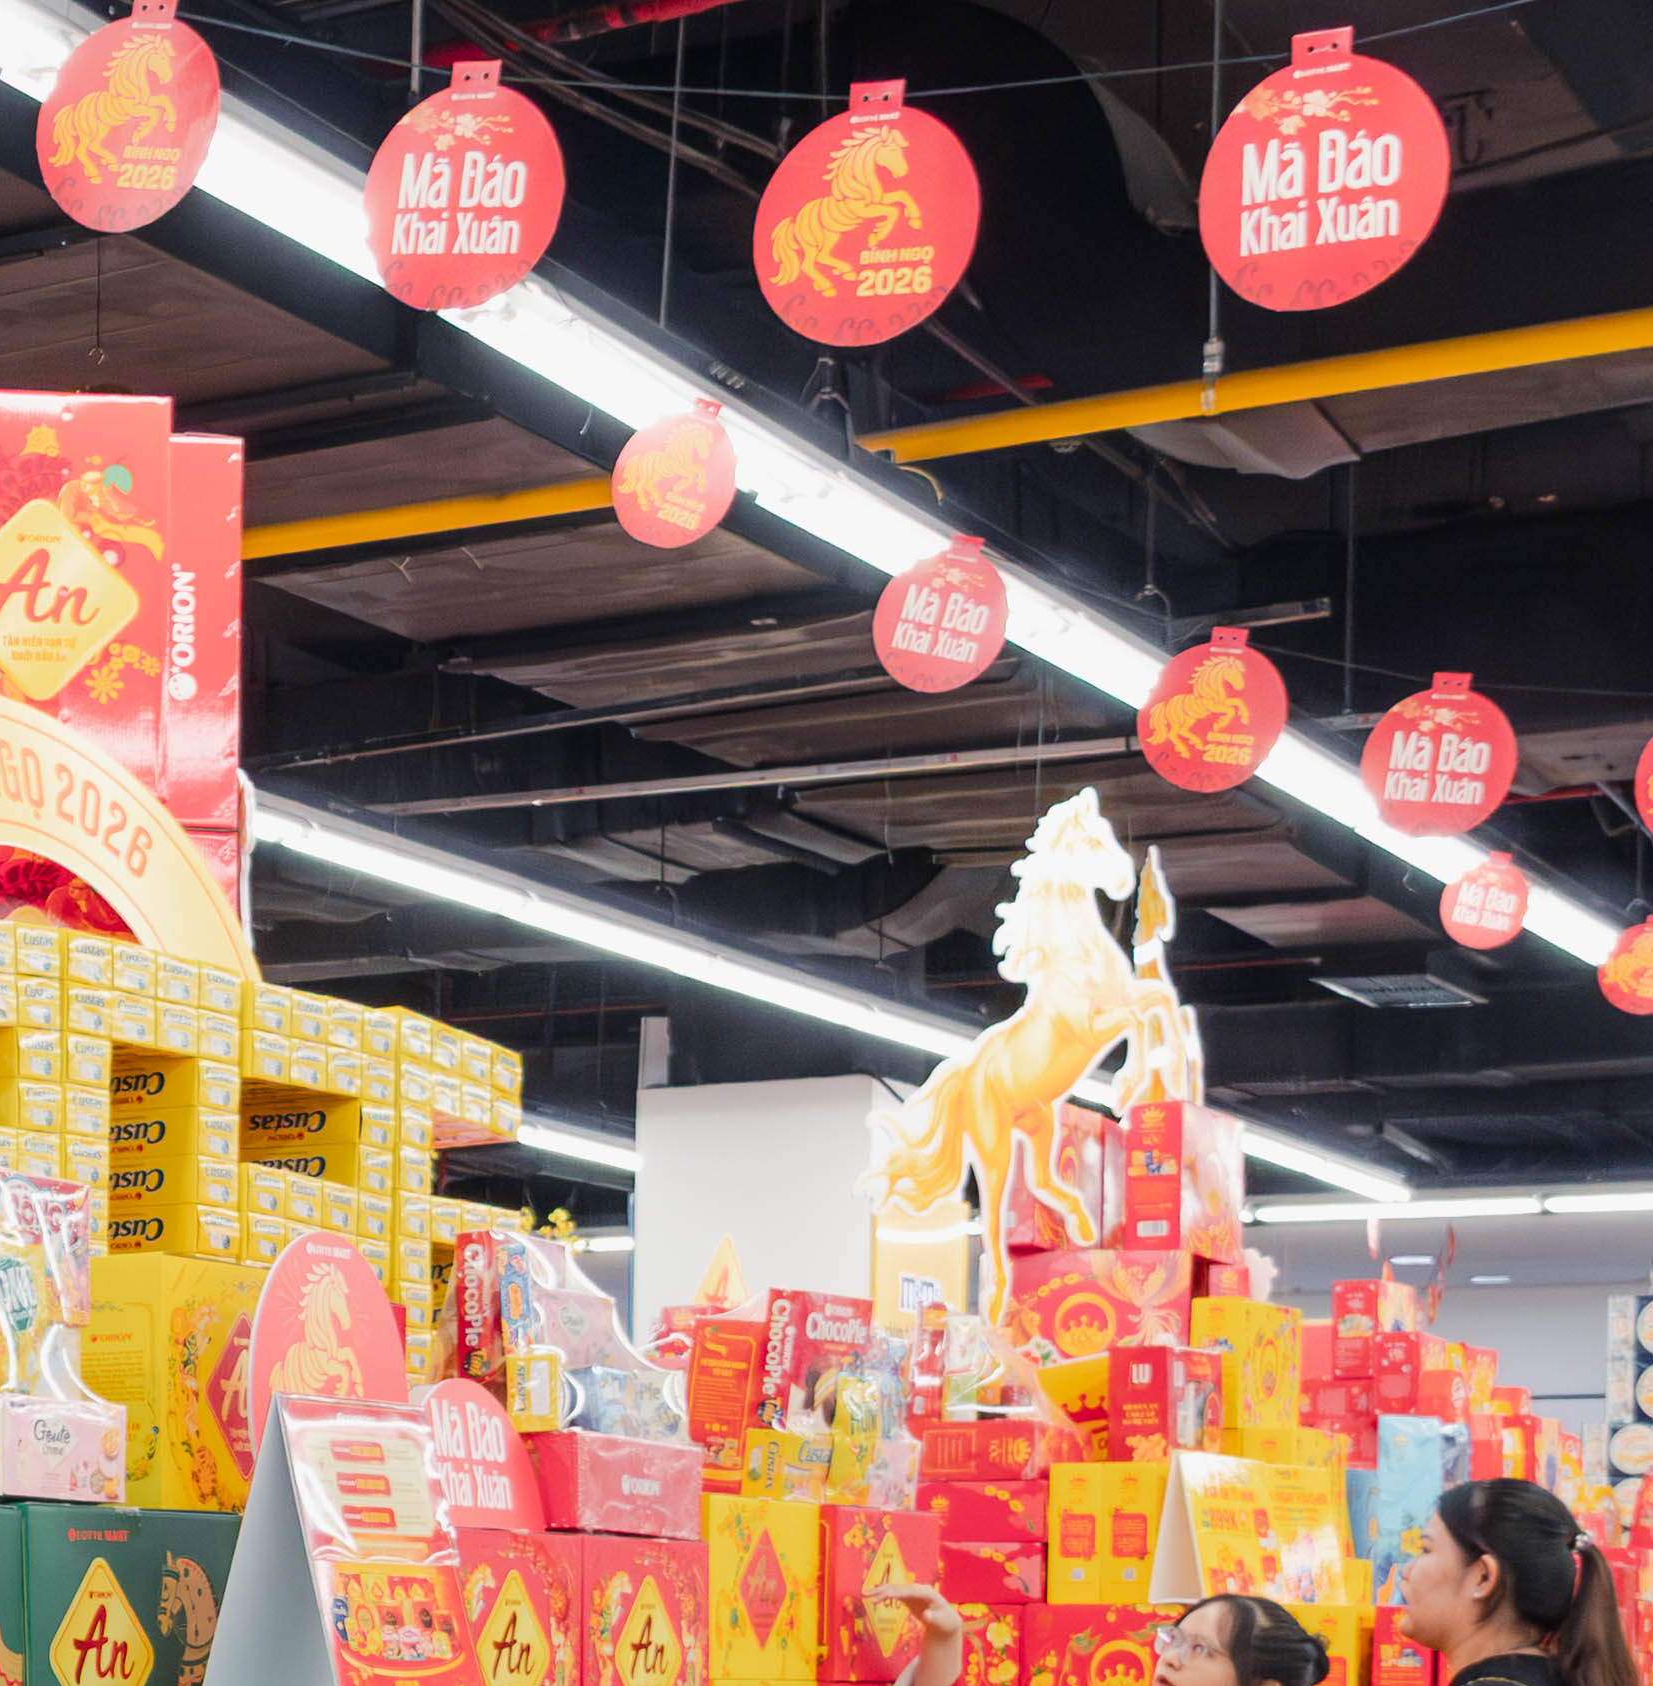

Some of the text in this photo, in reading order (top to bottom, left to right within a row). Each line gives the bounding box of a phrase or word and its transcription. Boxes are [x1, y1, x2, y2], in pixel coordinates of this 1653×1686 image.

[116, 162, 177, 191] 2026
[1239, 127, 1400, 204] Mã Đáo
[1239, 195, 1400, 257] Khai Xuân
[855, 265, 934, 297] 2026
[891, 620, 979, 664] Khai Xuân
[56, 763, 155, 879] 2026
[249, 1110, 326, 1136] Custas
[465, 1243, 484, 1348] ChocoPie
[805, 1310, 868, 1344] ChocoPie
[1131, 1362, 1152, 1385] LU
[433, 1400, 506, 1464] Mã Đáo
[471, 1465, 512, 1511] Xuân
[492, 1611, 532, 1677] An
